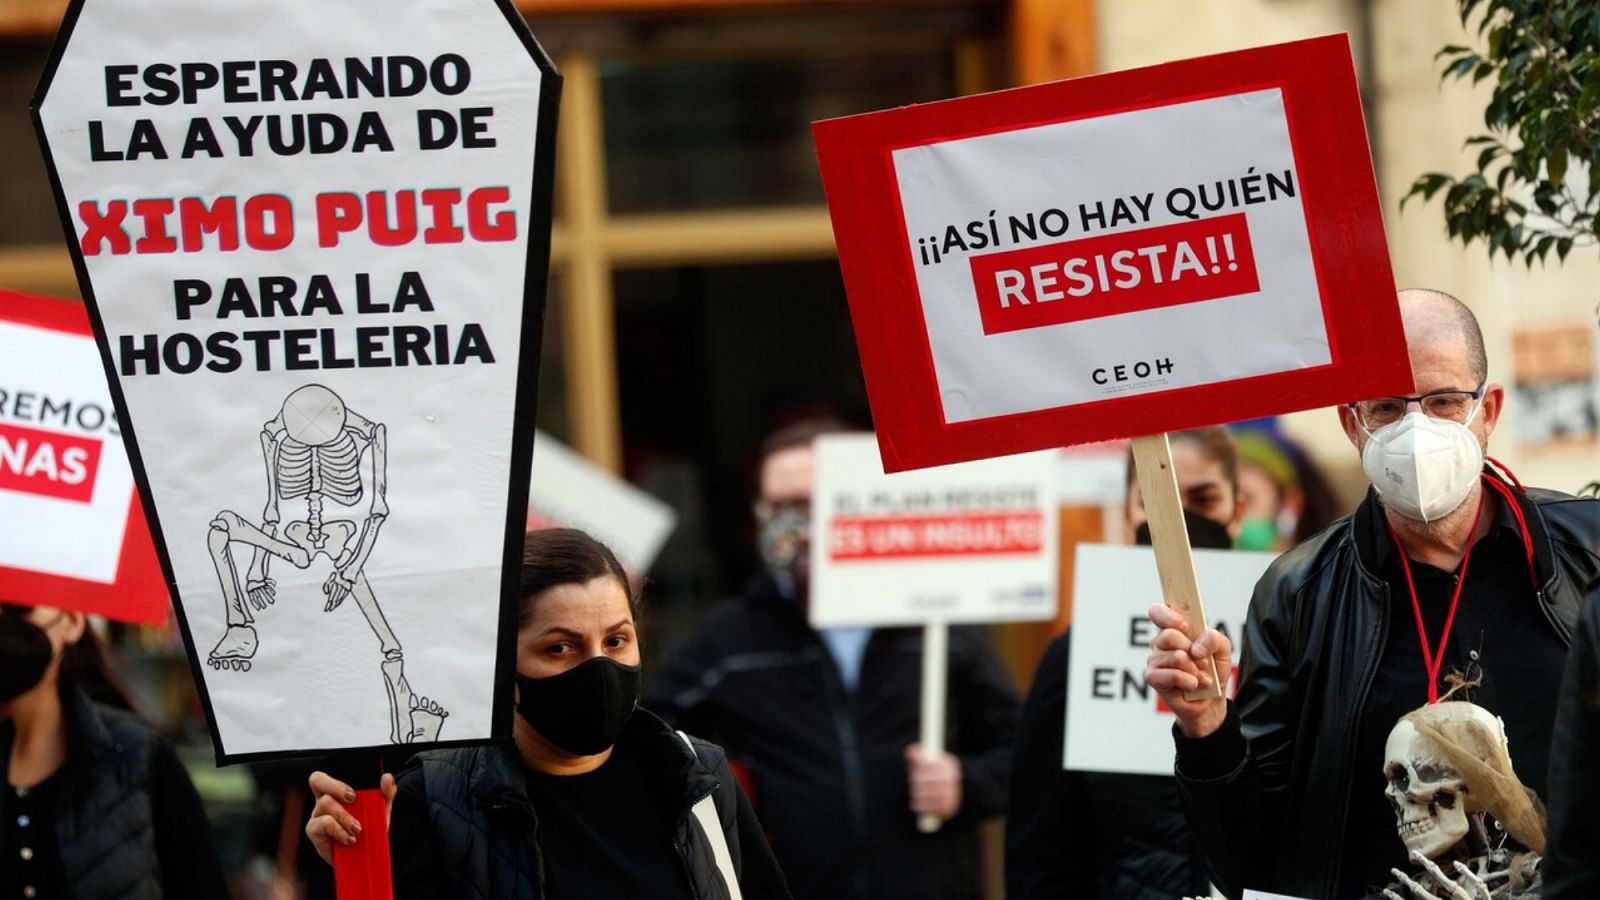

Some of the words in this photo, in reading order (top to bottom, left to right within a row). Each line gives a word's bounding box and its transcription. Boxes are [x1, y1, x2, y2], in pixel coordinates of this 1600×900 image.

[104, 53, 471, 107] ESPERANDO
[88, 118, 169, 162] LA
[181, 111, 395, 160] AYUDA
[416, 106, 497, 151] DE
[78, 194, 294, 257] XIMO
[314, 187, 517, 249] PUIG
[918, 209, 1000, 266] ¡¡ASÍ
[1008, 208, 1070, 244] NO
[1078, 192, 1154, 232] HAY
[1165, 166, 1296, 220] QUIÉN
[173, 274, 344, 321] PARA
[355, 271, 435, 315] LA
[994, 233, 1238, 308] RESISTA!!
[119, 323, 496, 377] HOSTELERIA
[869, 520, 916, 554] UN
[924, 516, 1041, 552] INSULTO
